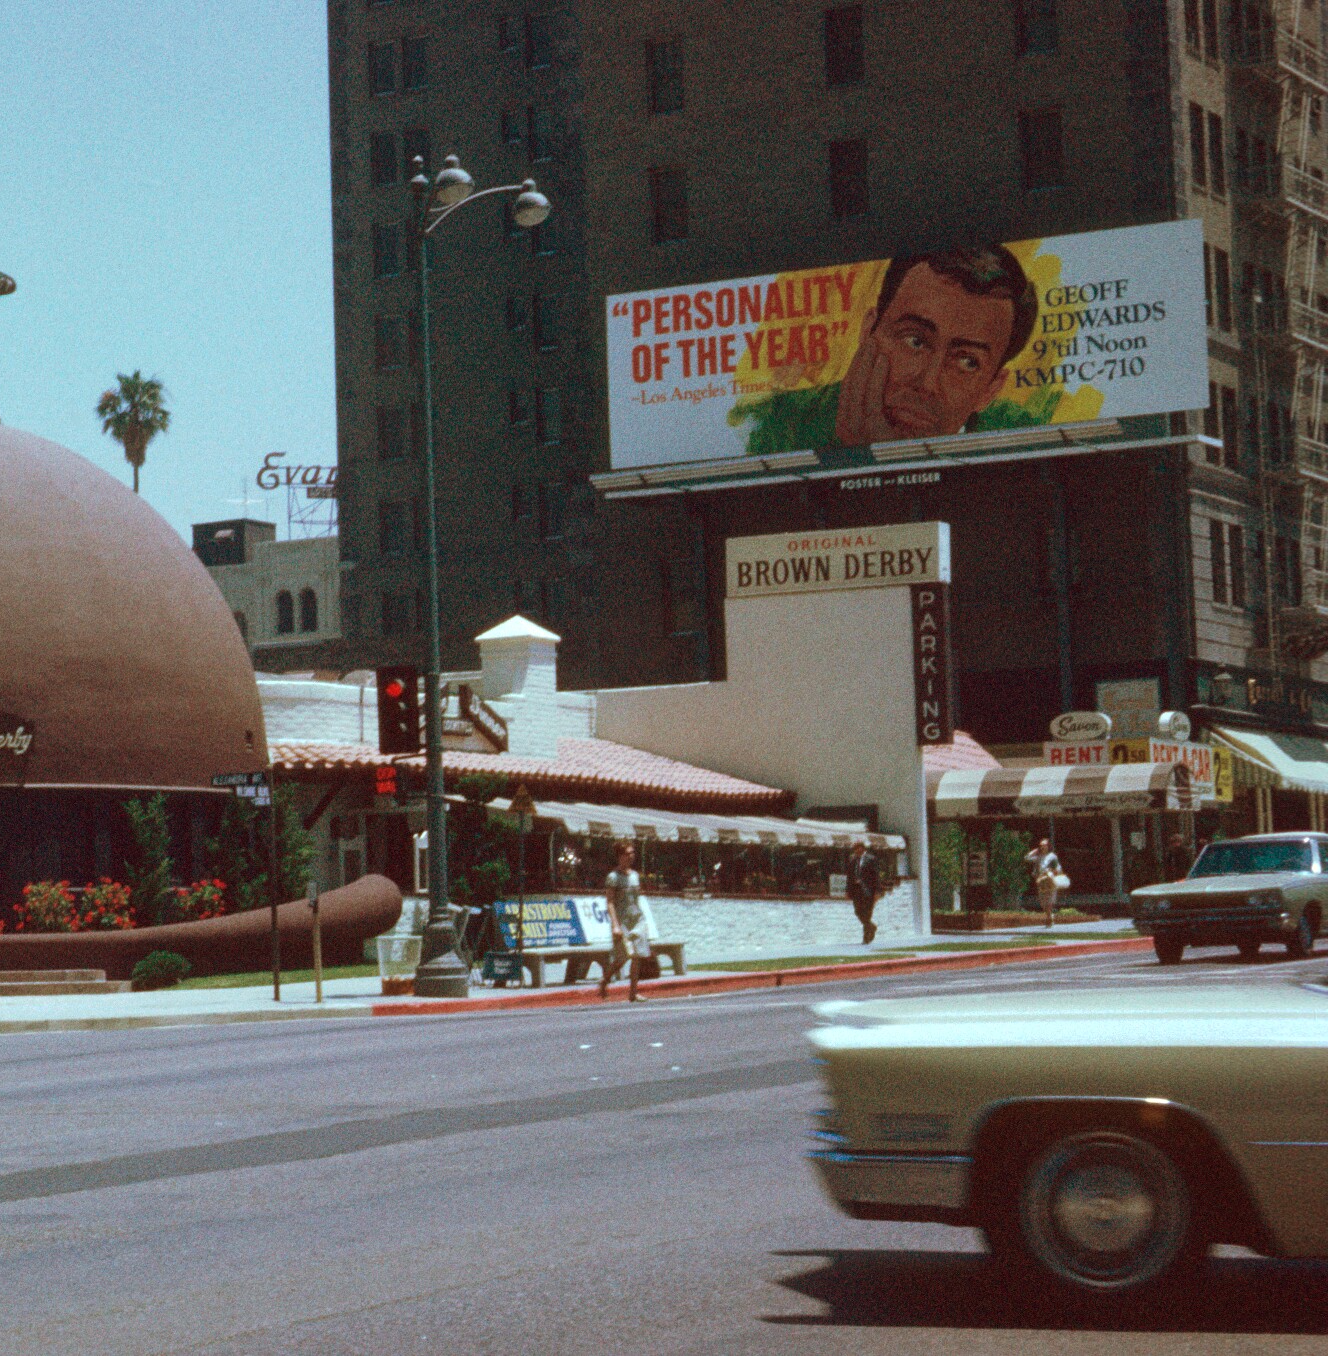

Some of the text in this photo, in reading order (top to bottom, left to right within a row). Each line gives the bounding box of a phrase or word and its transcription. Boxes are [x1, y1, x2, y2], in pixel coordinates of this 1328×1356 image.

[1045, 279, 1129, 308] GEOFF
[1042, 301, 1166, 334] EDWARDS
[631, 341, 670, 384] OF
[676, 334, 736, 379] THE
[1032, 341, 1046, 361] 9
[1086, 333, 1147, 352] Noon
[1015, 356, 1145, 388] KMPC-710
[672, 385, 726, 406] Angeles
[731, 378, 773, 397] Times
[787, 535, 876, 551] ORIGINAL
[737, 547, 933, 588] BROWN DERBY
[919, 591, 941, 741] PARKING
[1050, 746, 1104, 765] RENT
